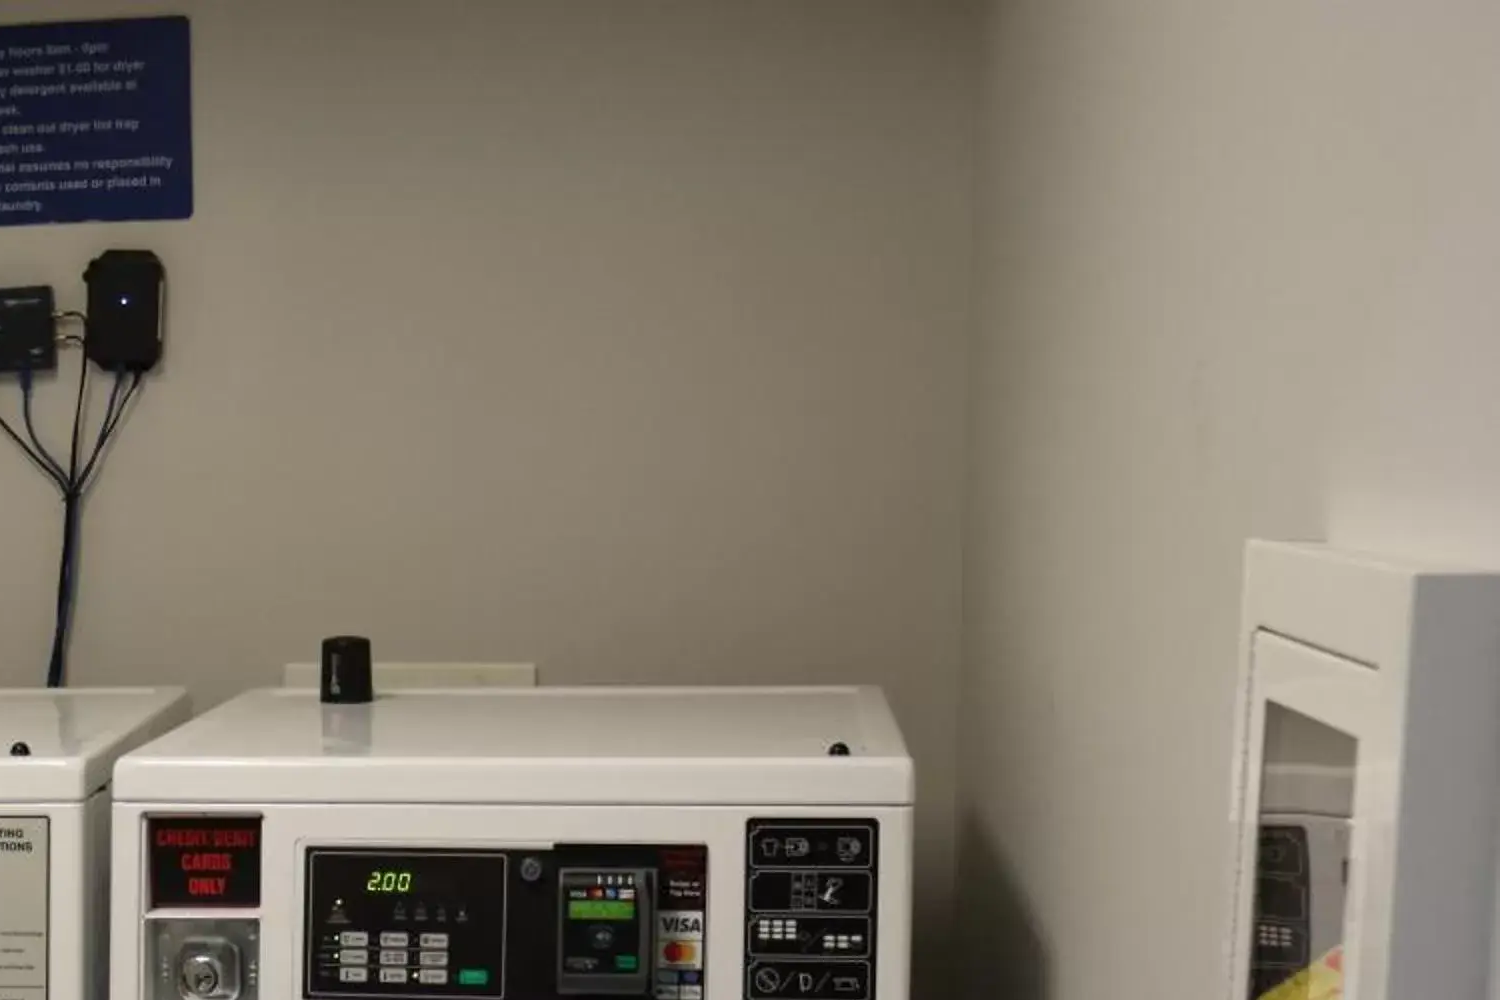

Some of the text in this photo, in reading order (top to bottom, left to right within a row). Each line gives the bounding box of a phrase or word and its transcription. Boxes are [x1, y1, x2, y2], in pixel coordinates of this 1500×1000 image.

[113, 59, 145, 73] dryer
[2, 123, 33, 135] clean
[59, 121, 90, 136] dryer
[19, 160, 70, 172] assumes
[92, 156, 173, 171] responsibility
[5, 180, 54, 192] contents
[59, 178, 88, 190] used
[107, 176, 146, 190] placed
[189, 878, 225, 895] ONLY
[367, 872, 411, 892] 2.00
[662, 917, 701, 932] VISA
